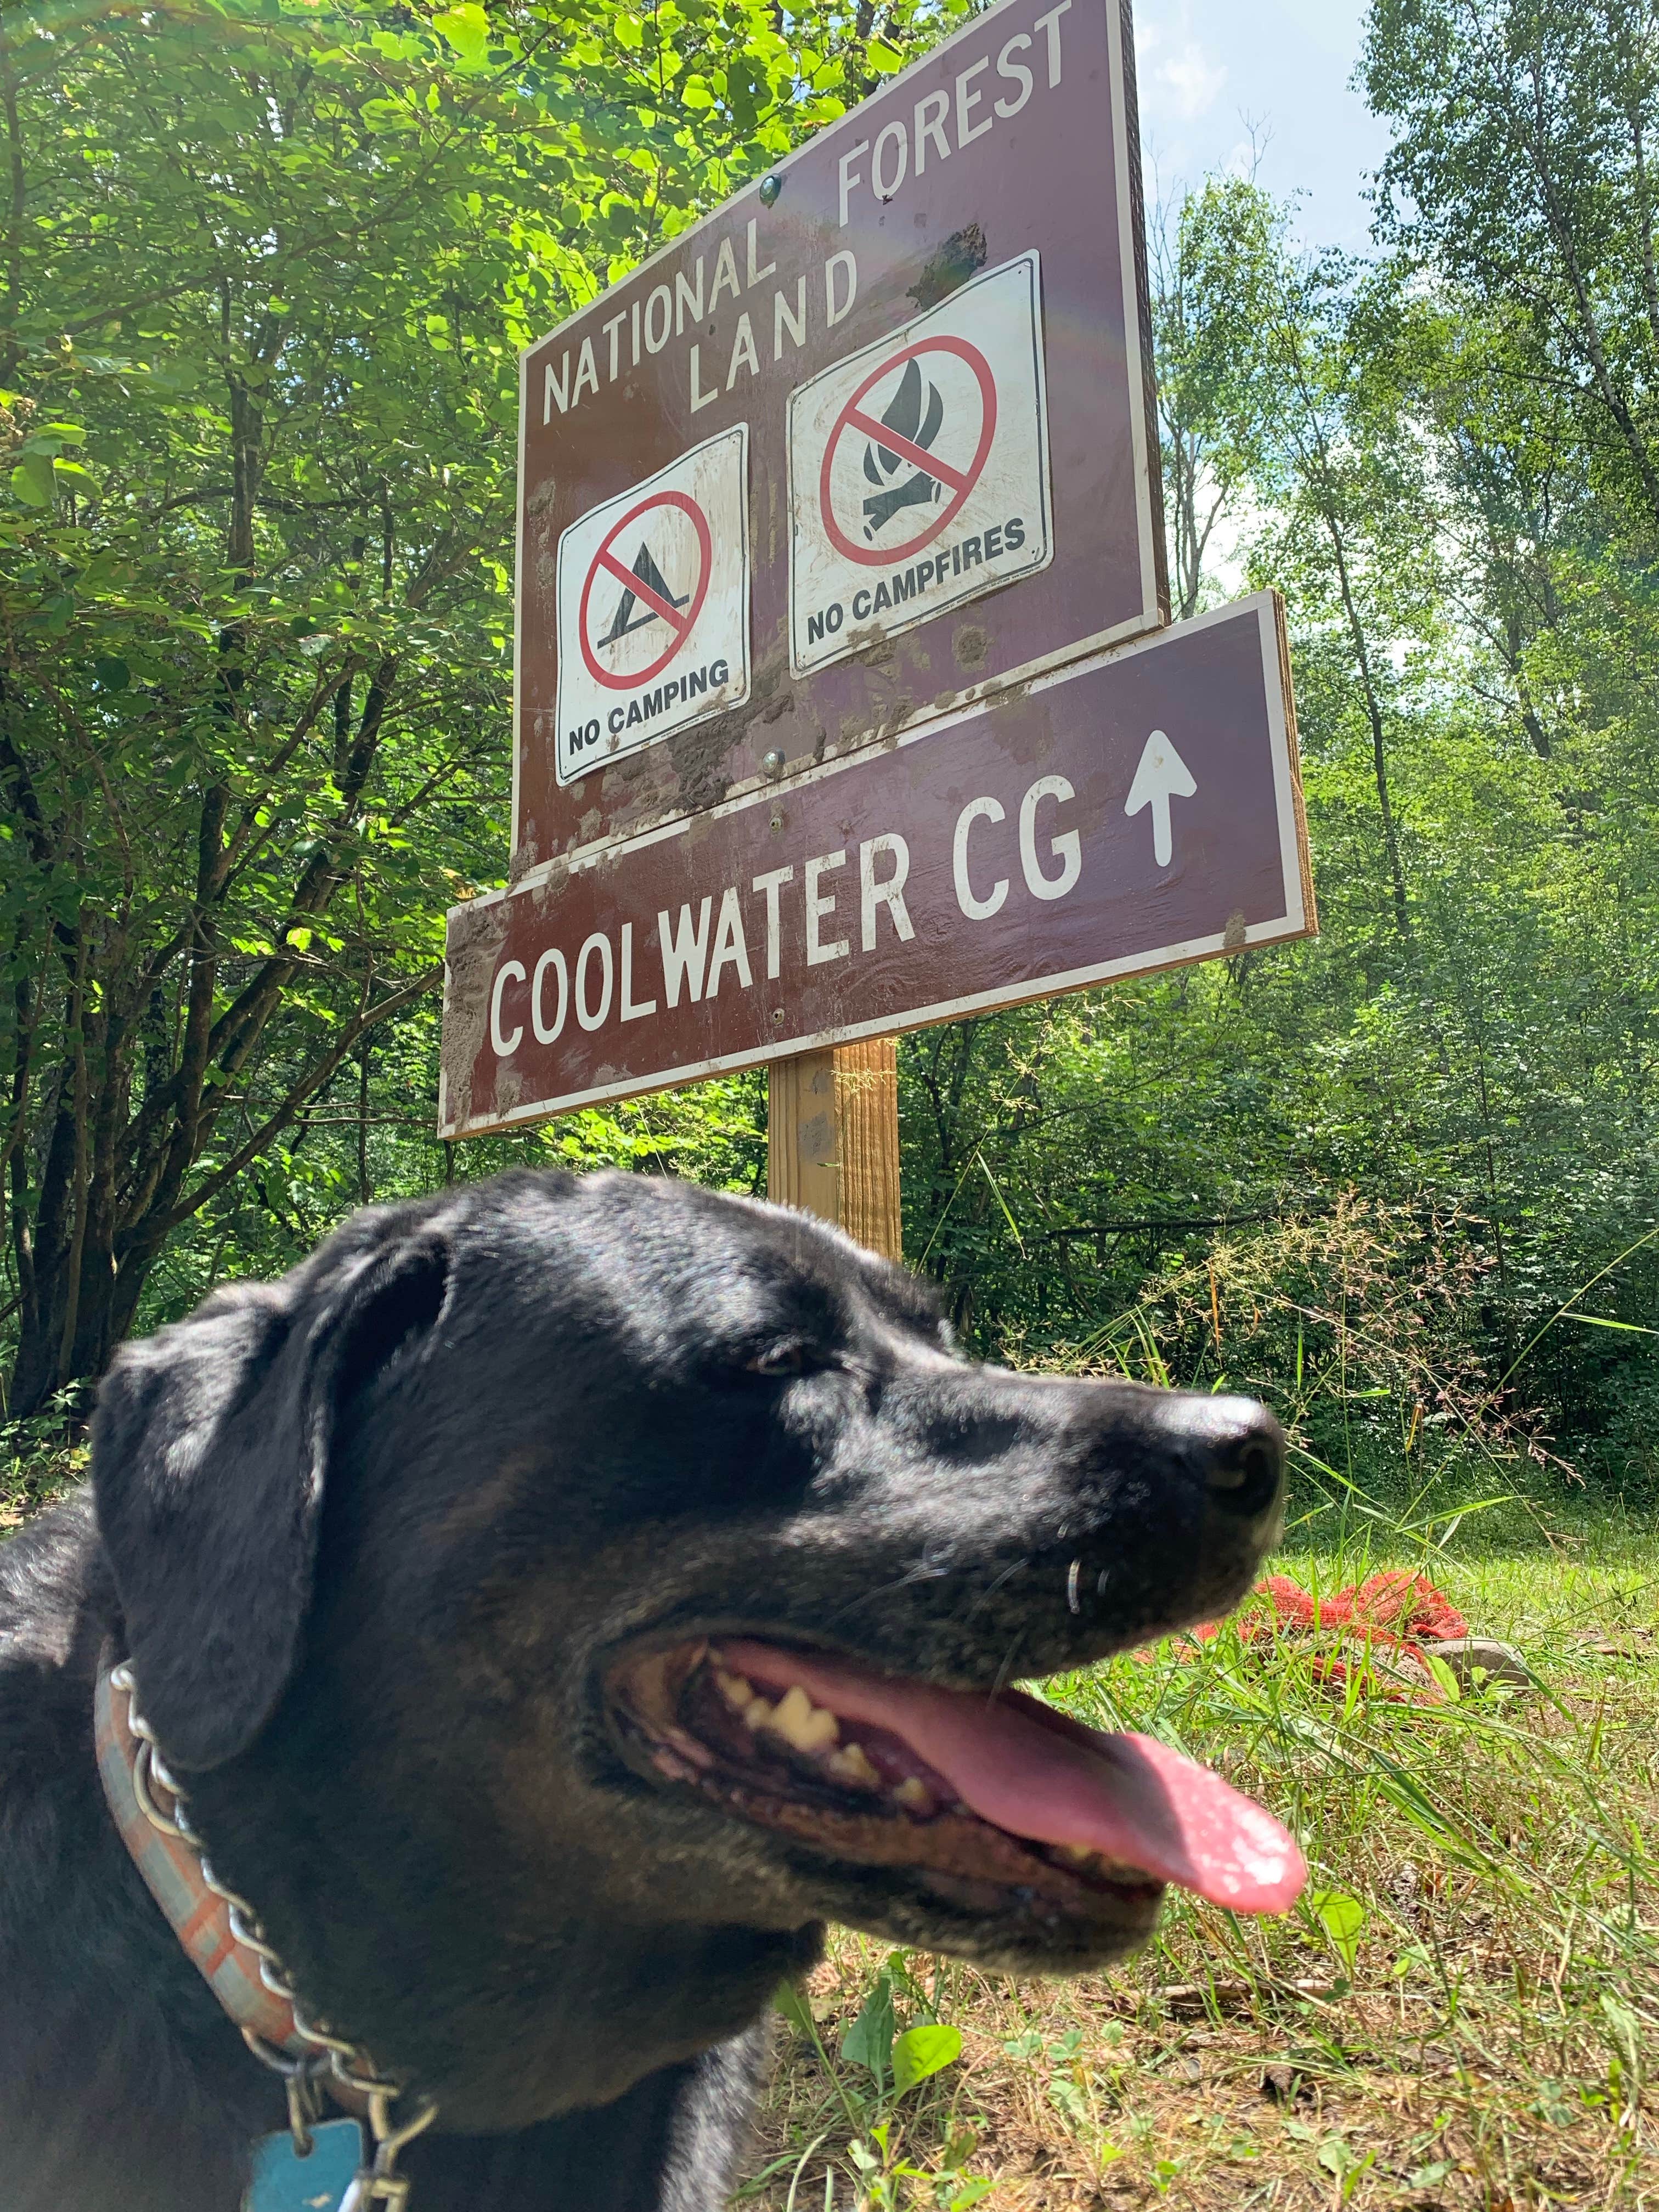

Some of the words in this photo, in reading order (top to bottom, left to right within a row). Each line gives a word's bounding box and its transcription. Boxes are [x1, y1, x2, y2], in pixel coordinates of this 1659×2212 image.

[543, 218, 776, 425] NATIONAL
[838, 0, 1072, 227] FOREST
[690, 250, 857, 413] LAND
[808, 603, 843, 644] NO
[852, 517, 1025, 621] CAMPFIRES
[569, 719, 599, 755] NO
[608, 659, 729, 734] CAMPING
[490, 833, 915, 1057] COOLWATER
[953, 775, 1081, 921] CG
